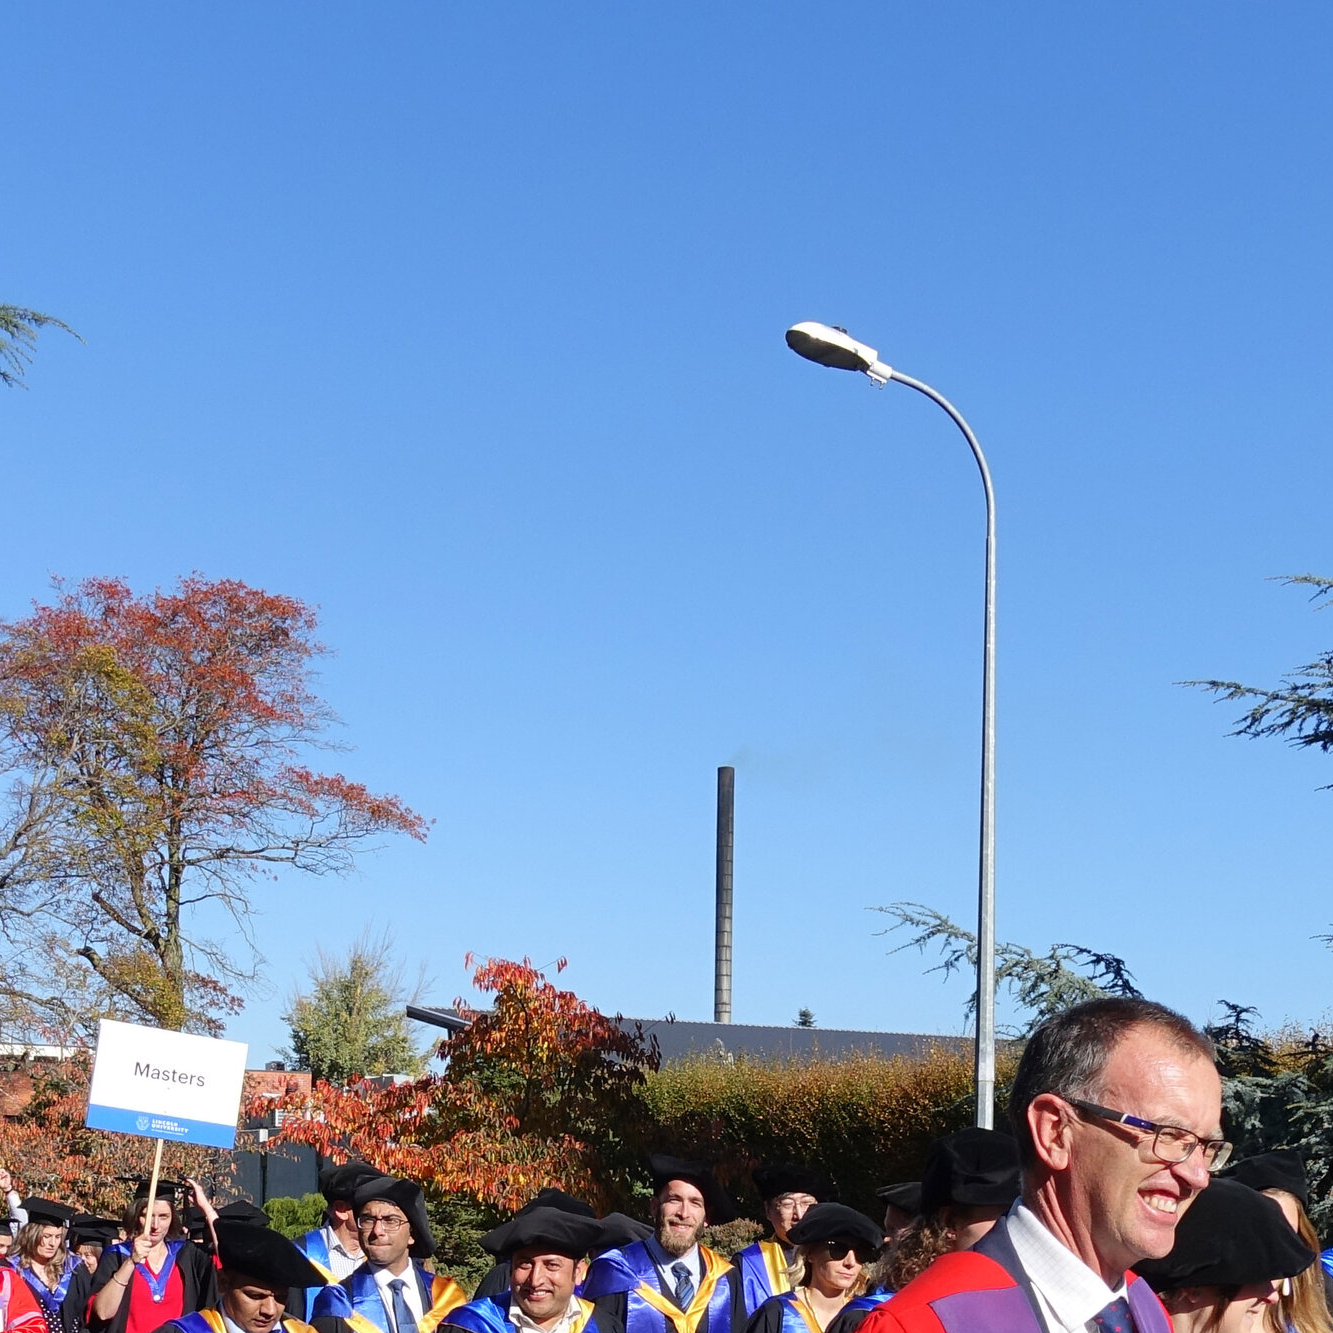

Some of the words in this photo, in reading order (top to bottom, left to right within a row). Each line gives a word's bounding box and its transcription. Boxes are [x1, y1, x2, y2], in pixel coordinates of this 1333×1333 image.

[134, 1061, 205, 1087] Masters
[152, 1118, 178, 1127] LINCOLN
[151, 1123, 189, 1133] UNIVERSITY
